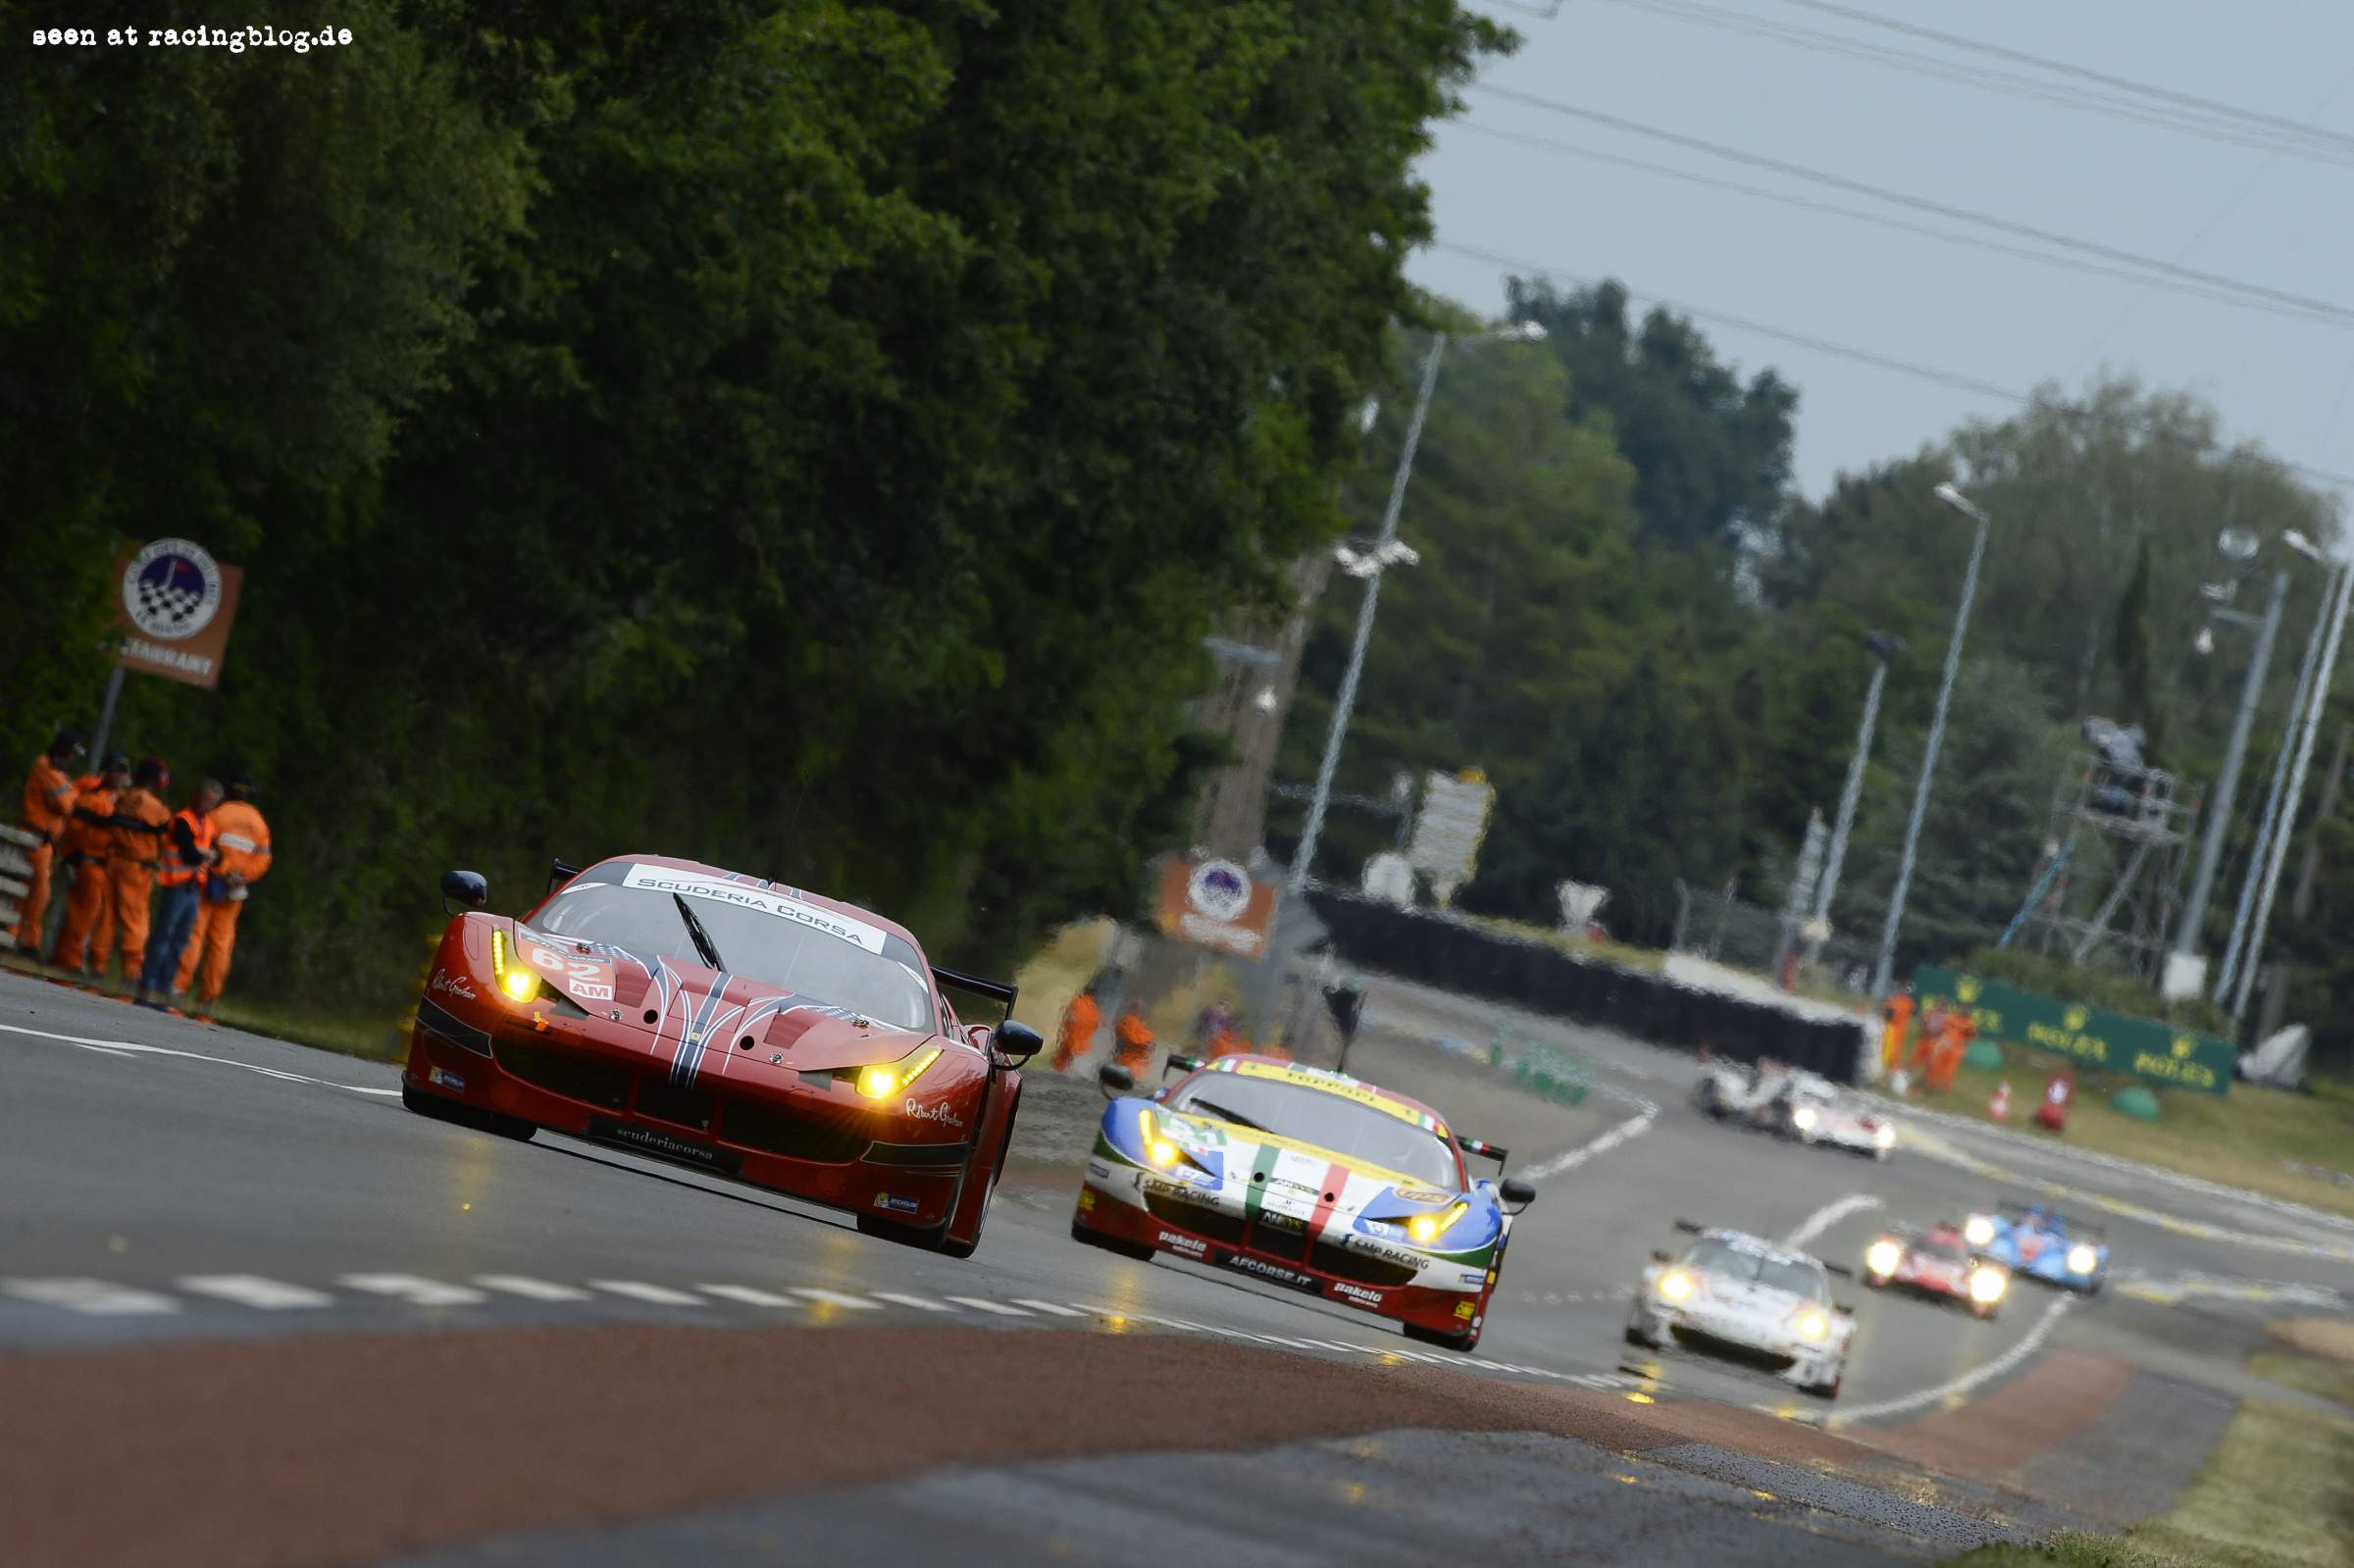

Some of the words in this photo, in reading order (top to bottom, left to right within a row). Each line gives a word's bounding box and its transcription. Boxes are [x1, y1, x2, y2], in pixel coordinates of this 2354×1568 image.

[638, 878, 768, 909] SCUDERIA
[776, 904, 864, 945] CORSA
[532, 947, 601, 982] 62
[572, 983, 610, 998] AM
[616, 1128, 714, 1160] scuderiacorsa
[1229, 1254, 1312, 1287] AFCORSE.IT
[1382, 1248, 1431, 1270] RACING
[1333, 1282, 1383, 1303] pakelo
